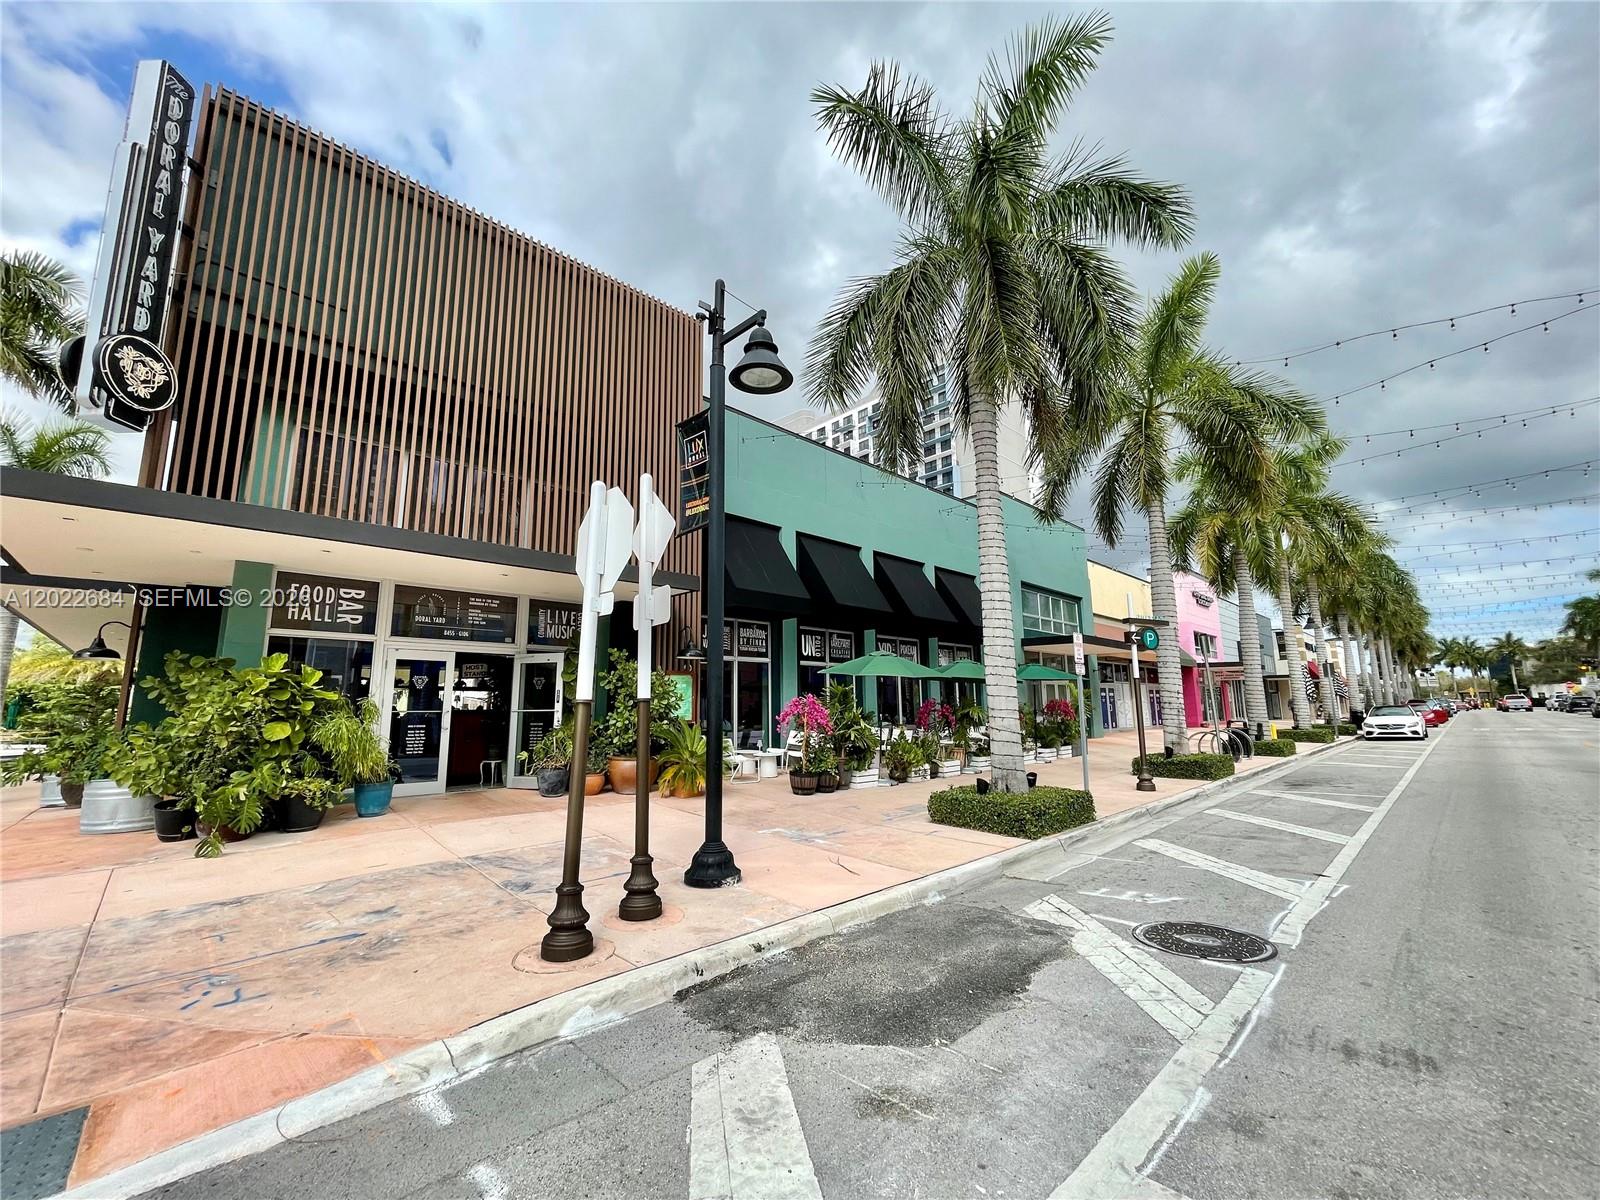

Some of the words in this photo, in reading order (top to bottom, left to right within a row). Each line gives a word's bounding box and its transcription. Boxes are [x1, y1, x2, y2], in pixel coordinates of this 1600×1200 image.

[166, 75, 189, 100] The
[153, 94, 184, 220] DORAL
[132, 226, 166, 333] YARD
[290, 583, 335, 604] FOOD
[287, 602, 332, 622] HALL
[336, 588, 365, 625] BAR
[415, 615, 431, 623] DORAL
[433, 616, 446, 624] YARD
[547, 609, 577, 626] LIVE
[546, 624, 576, 640] MUSIC
[1146, 632, 1154, 645] P
[801, 634, 815, 657] UN
